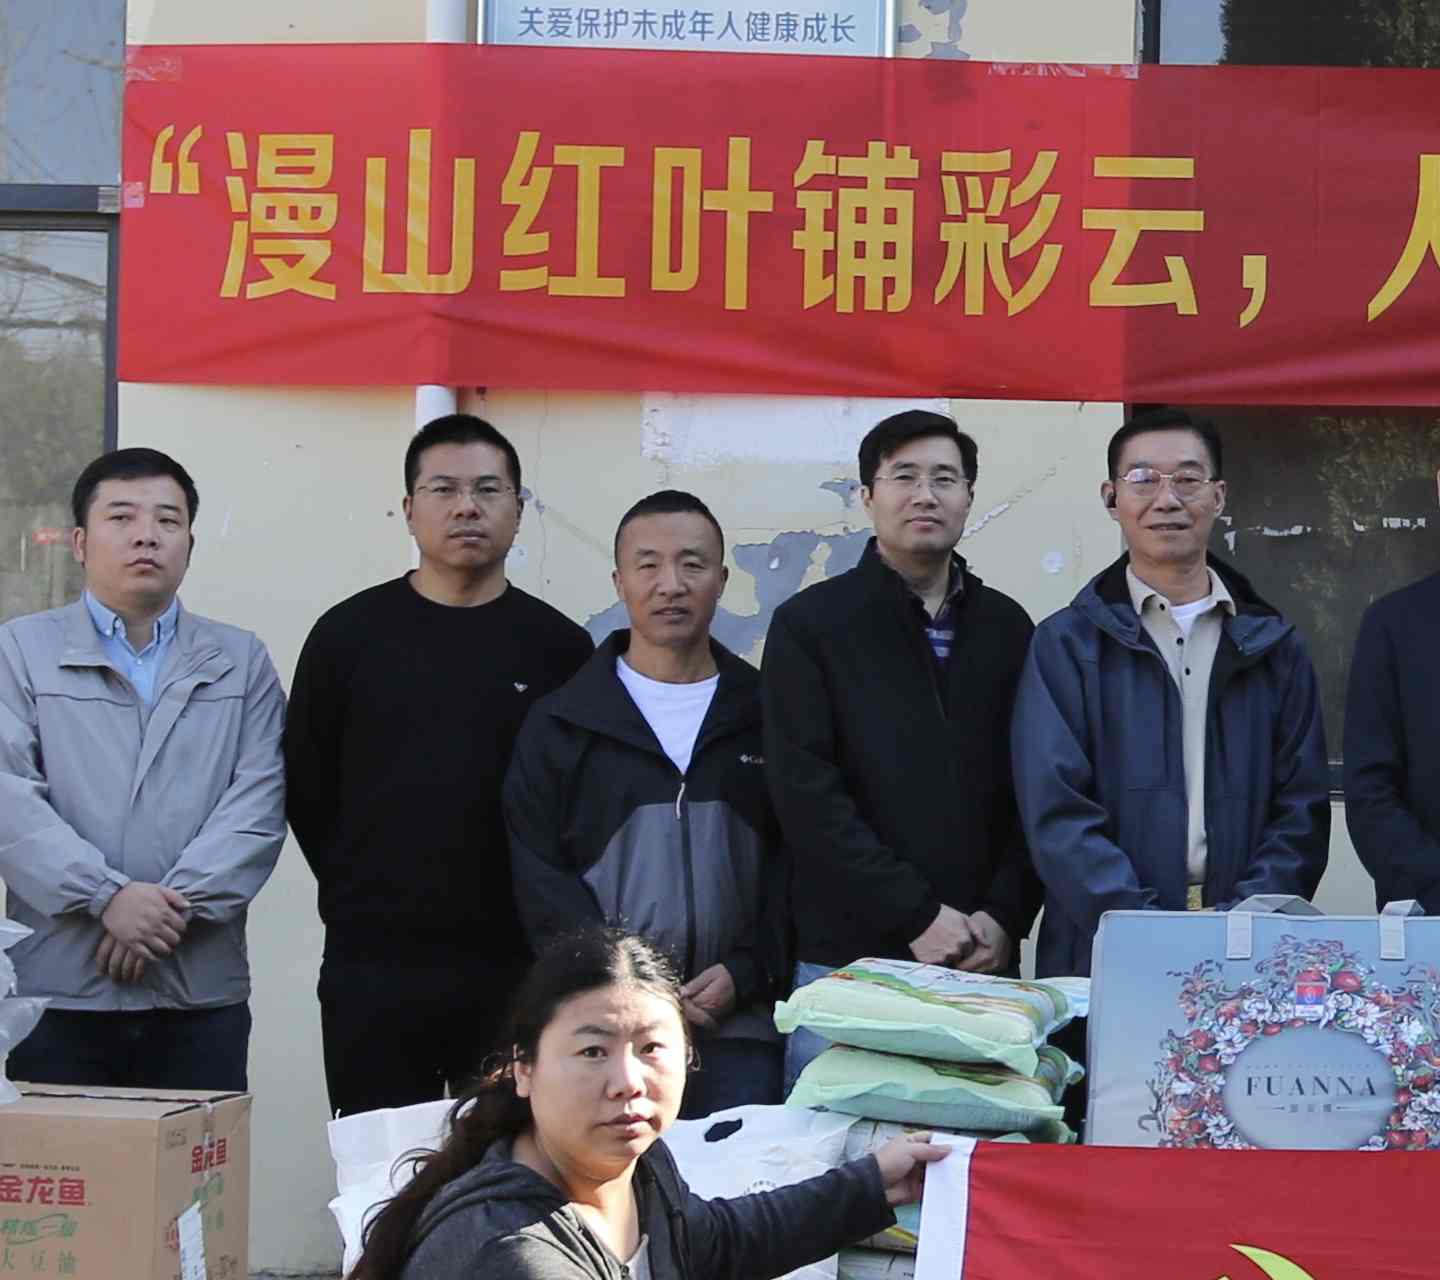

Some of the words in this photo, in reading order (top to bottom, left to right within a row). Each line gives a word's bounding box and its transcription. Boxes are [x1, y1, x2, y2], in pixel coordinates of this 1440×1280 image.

[518, 6, 855, 43] 关爱保护未成年人健康成长
[1245, 1075, 1378, 1097] FUANNA
[1, 1250, 77, 1274] 大豆油
